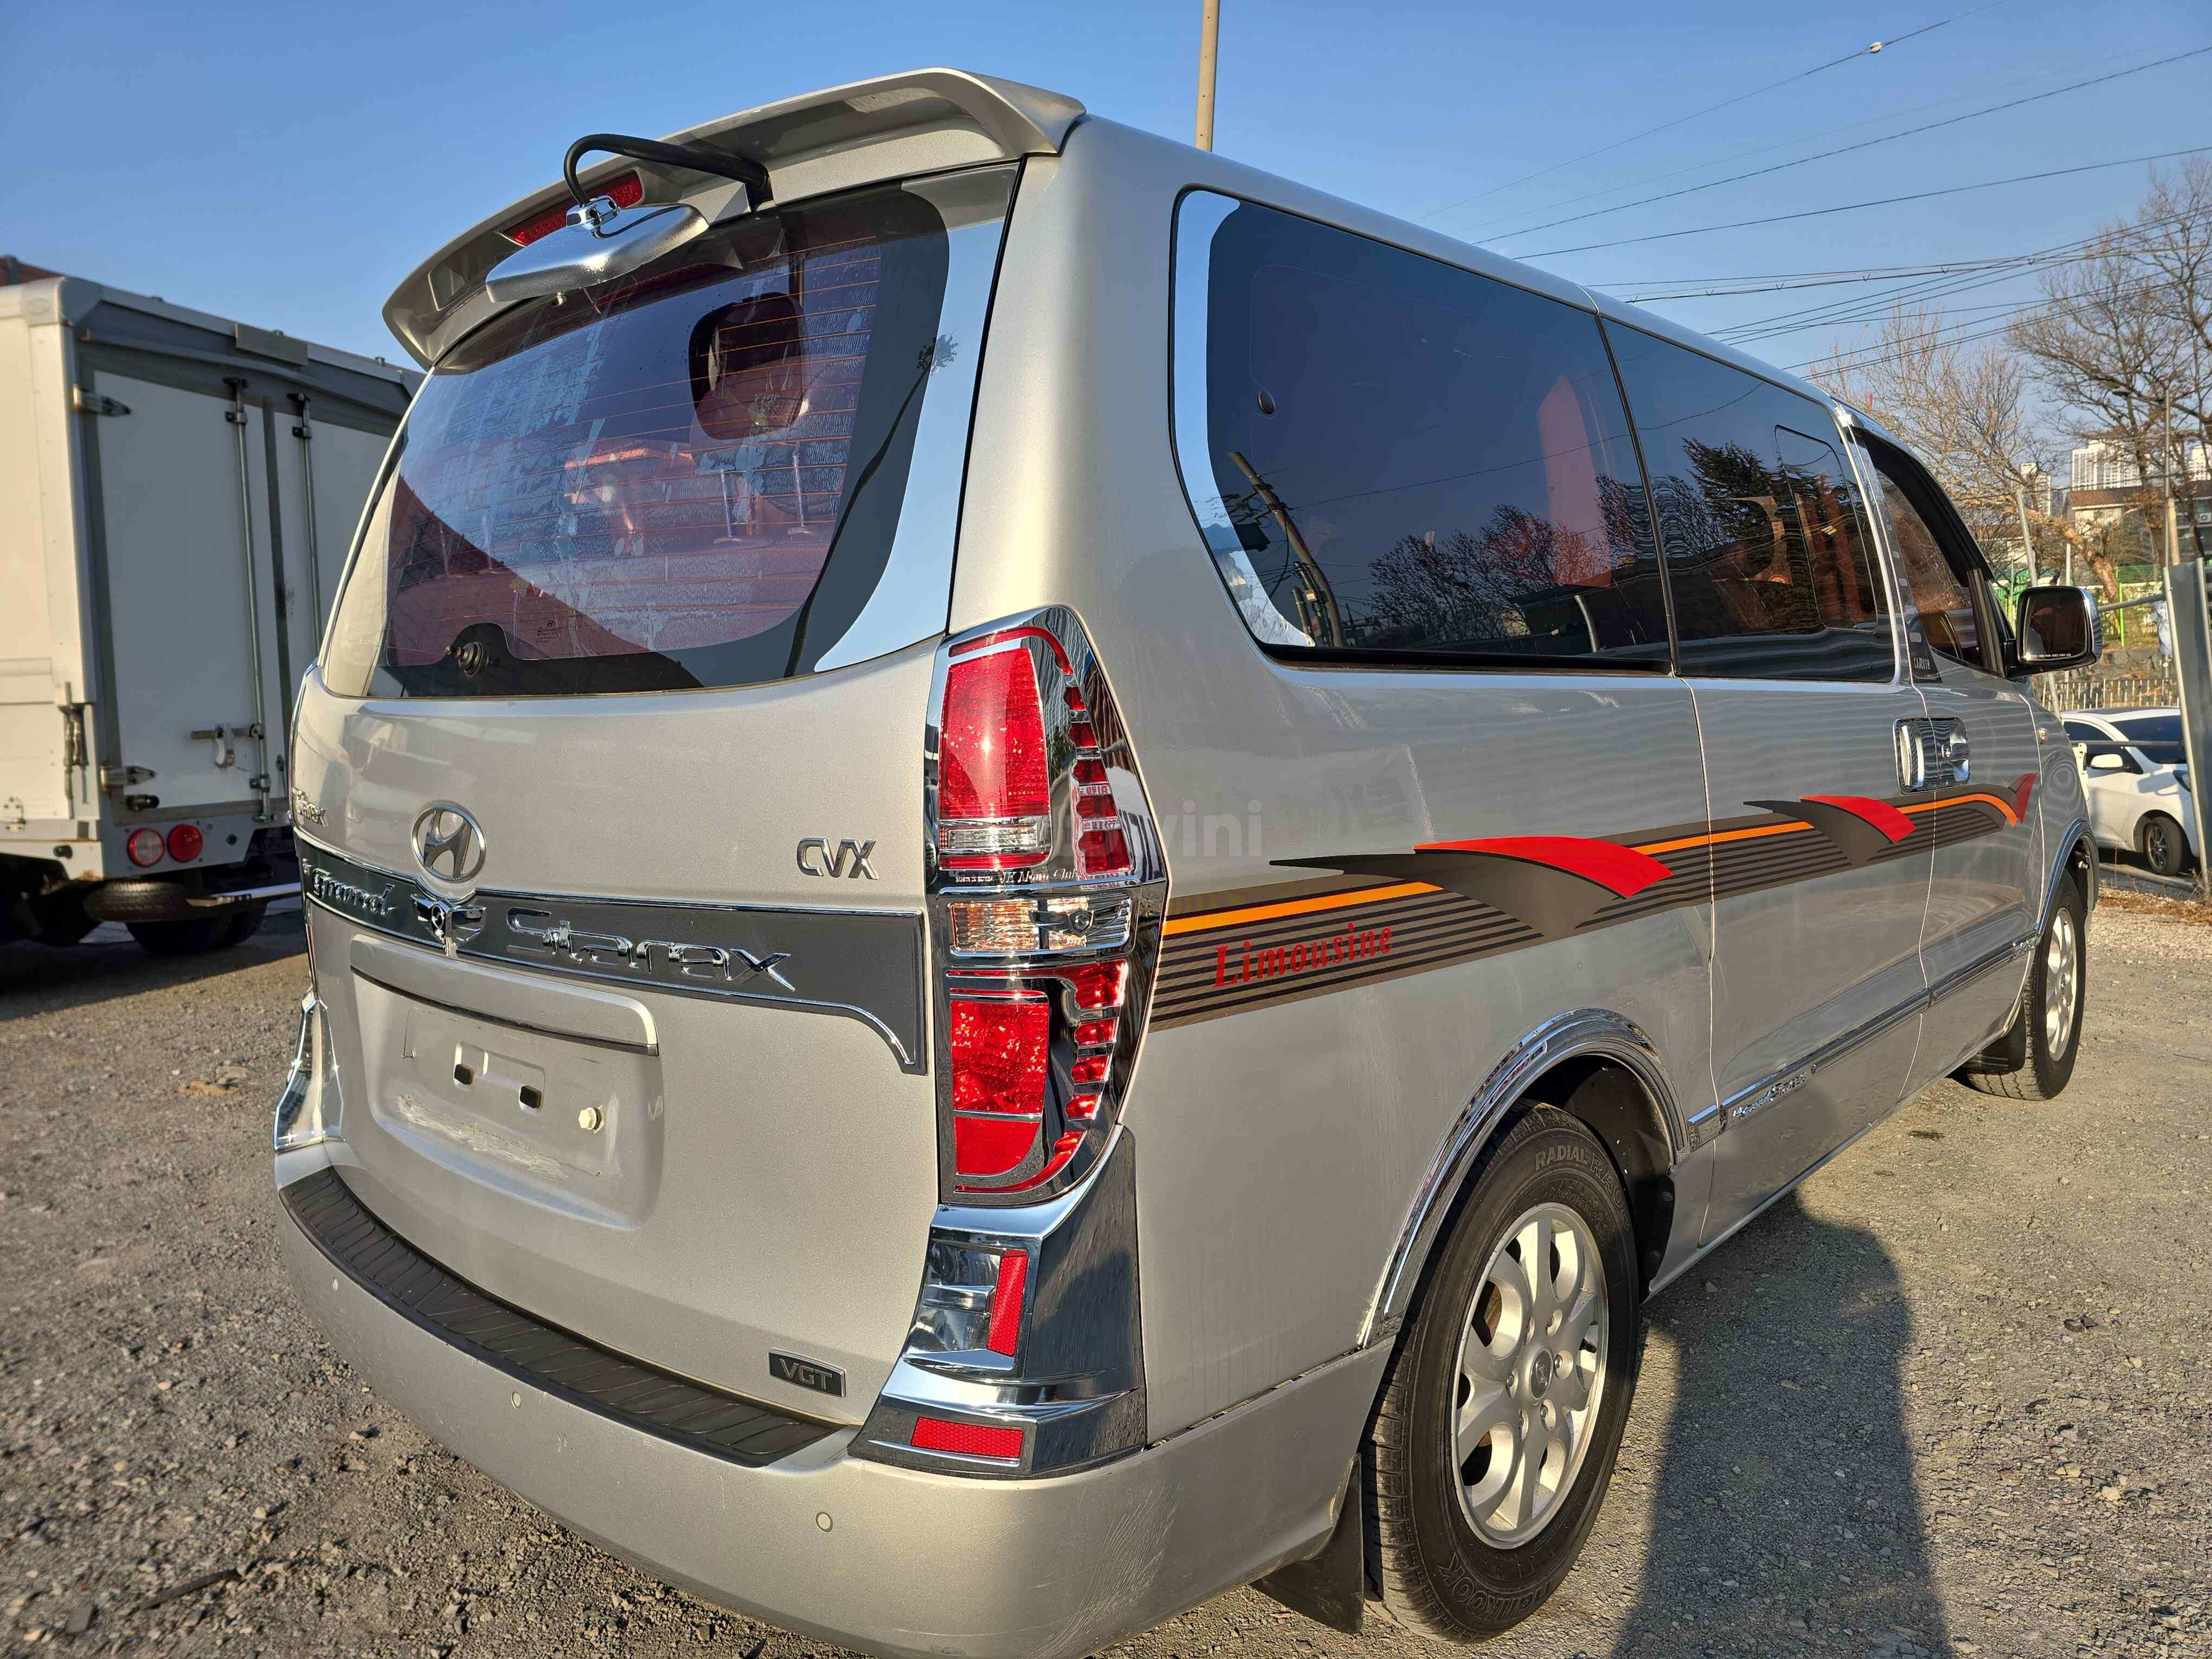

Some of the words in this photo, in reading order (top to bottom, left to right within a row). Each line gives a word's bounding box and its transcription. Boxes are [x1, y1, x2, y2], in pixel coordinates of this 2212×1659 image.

[796, 837, 879, 880] CVX
[312, 867, 397, 916] Grand
[506, 906, 796, 992] Starex
[1212, 922, 1393, 989] Limousine
[1535, 1144, 1587, 1171] RADIAL
[779, 1358, 833, 1390] VGT
